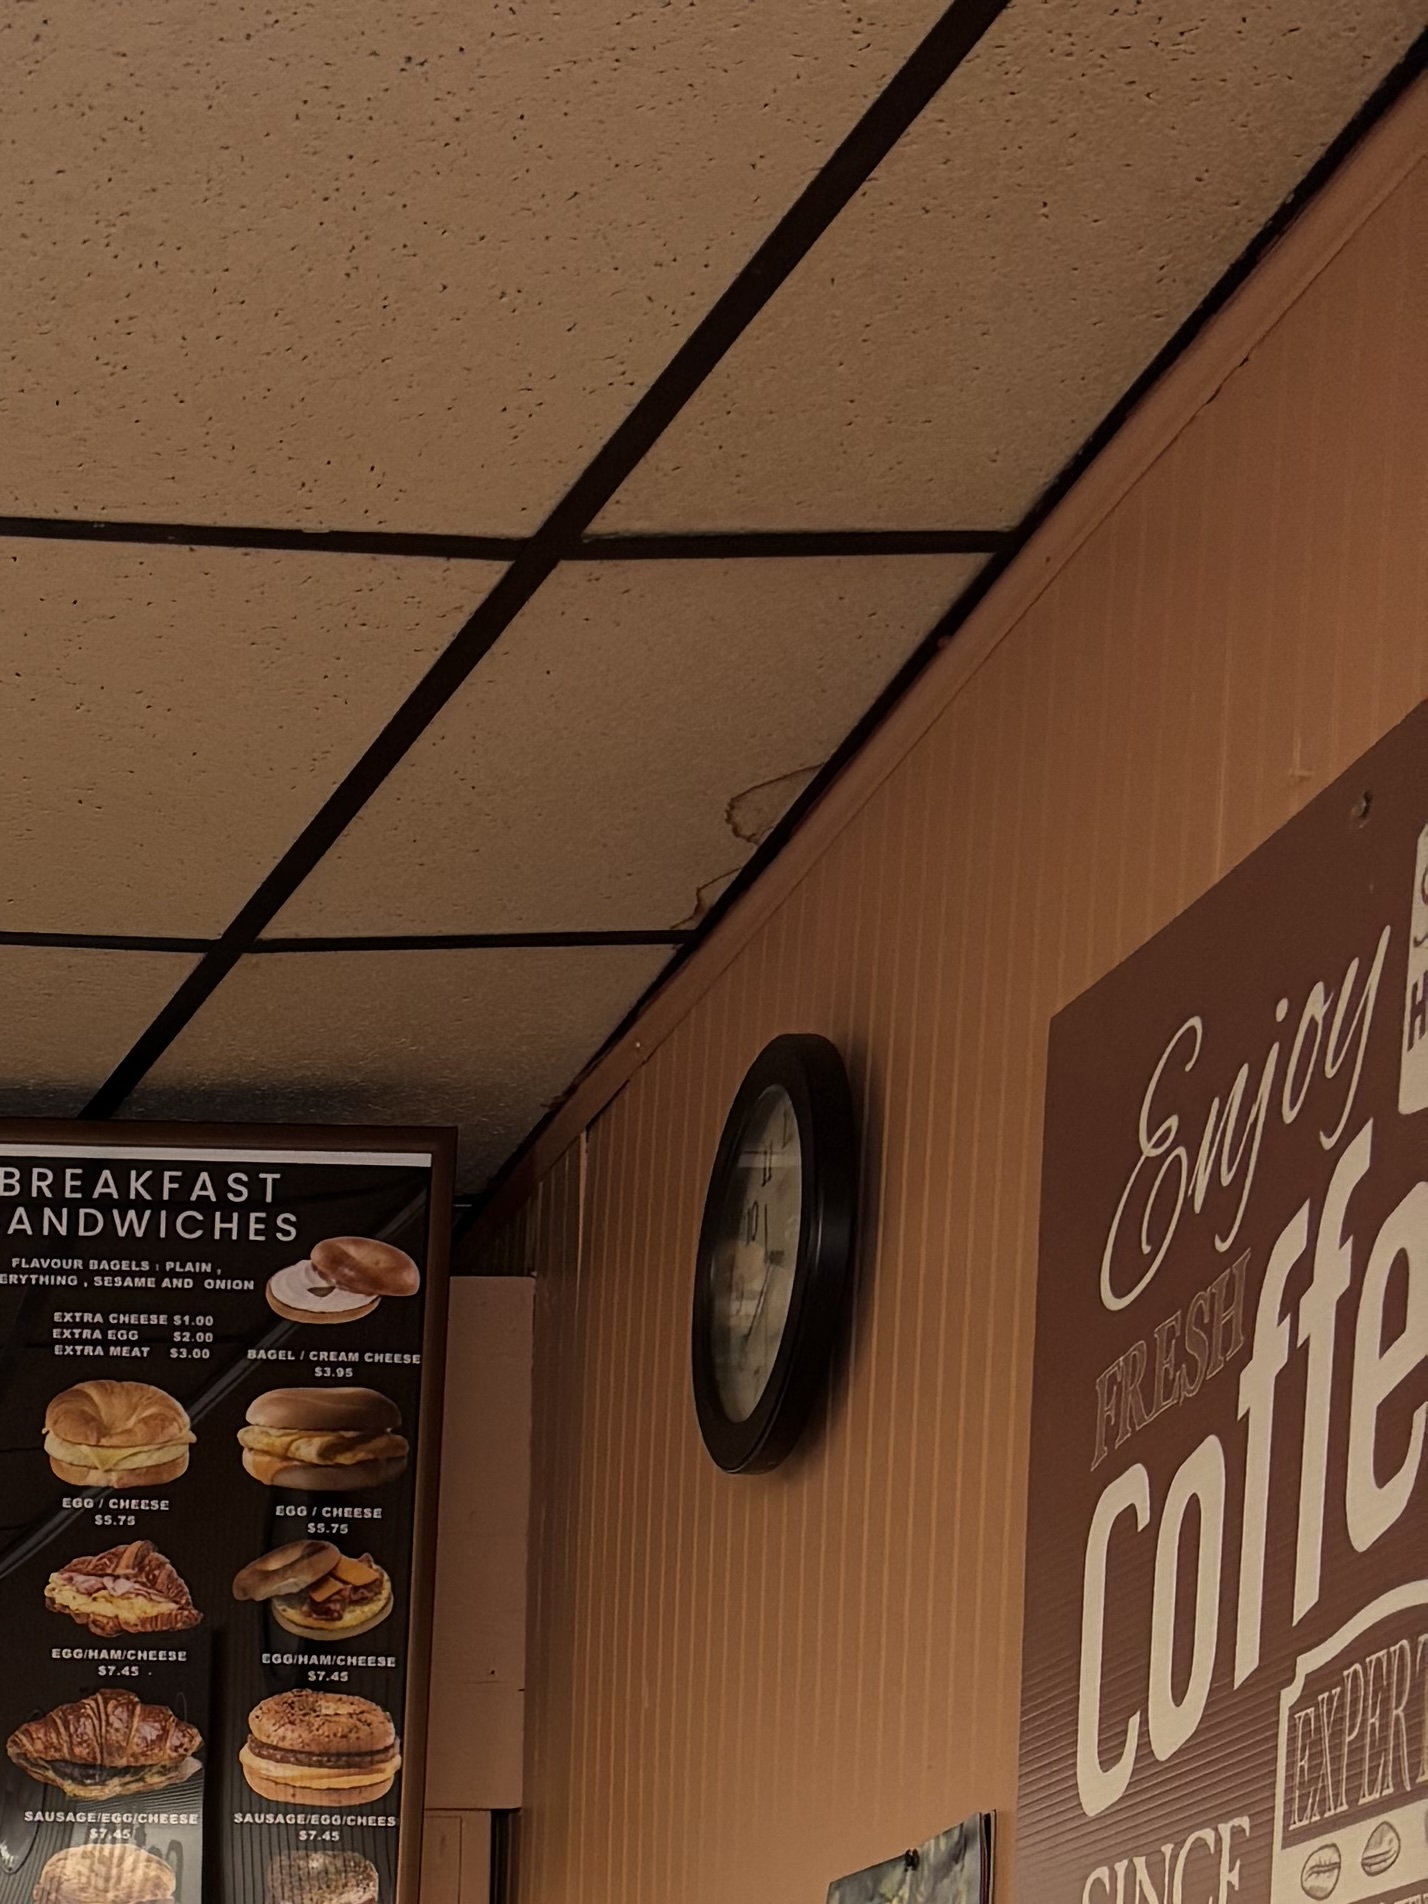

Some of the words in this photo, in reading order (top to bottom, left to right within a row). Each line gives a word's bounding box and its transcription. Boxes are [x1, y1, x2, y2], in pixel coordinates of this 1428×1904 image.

[1100, 925, 1392, 1311] Enjoy
[54, 1312, 101, 1325] EXTRA
[108, 1312, 168, 1326] CHEESE
[173, 1314, 213, 1327] $1.00
[1090, 1248, 1250, 1473] FRESH
[51, 1648, 187, 1662] EGG/HAM/CHEESE
